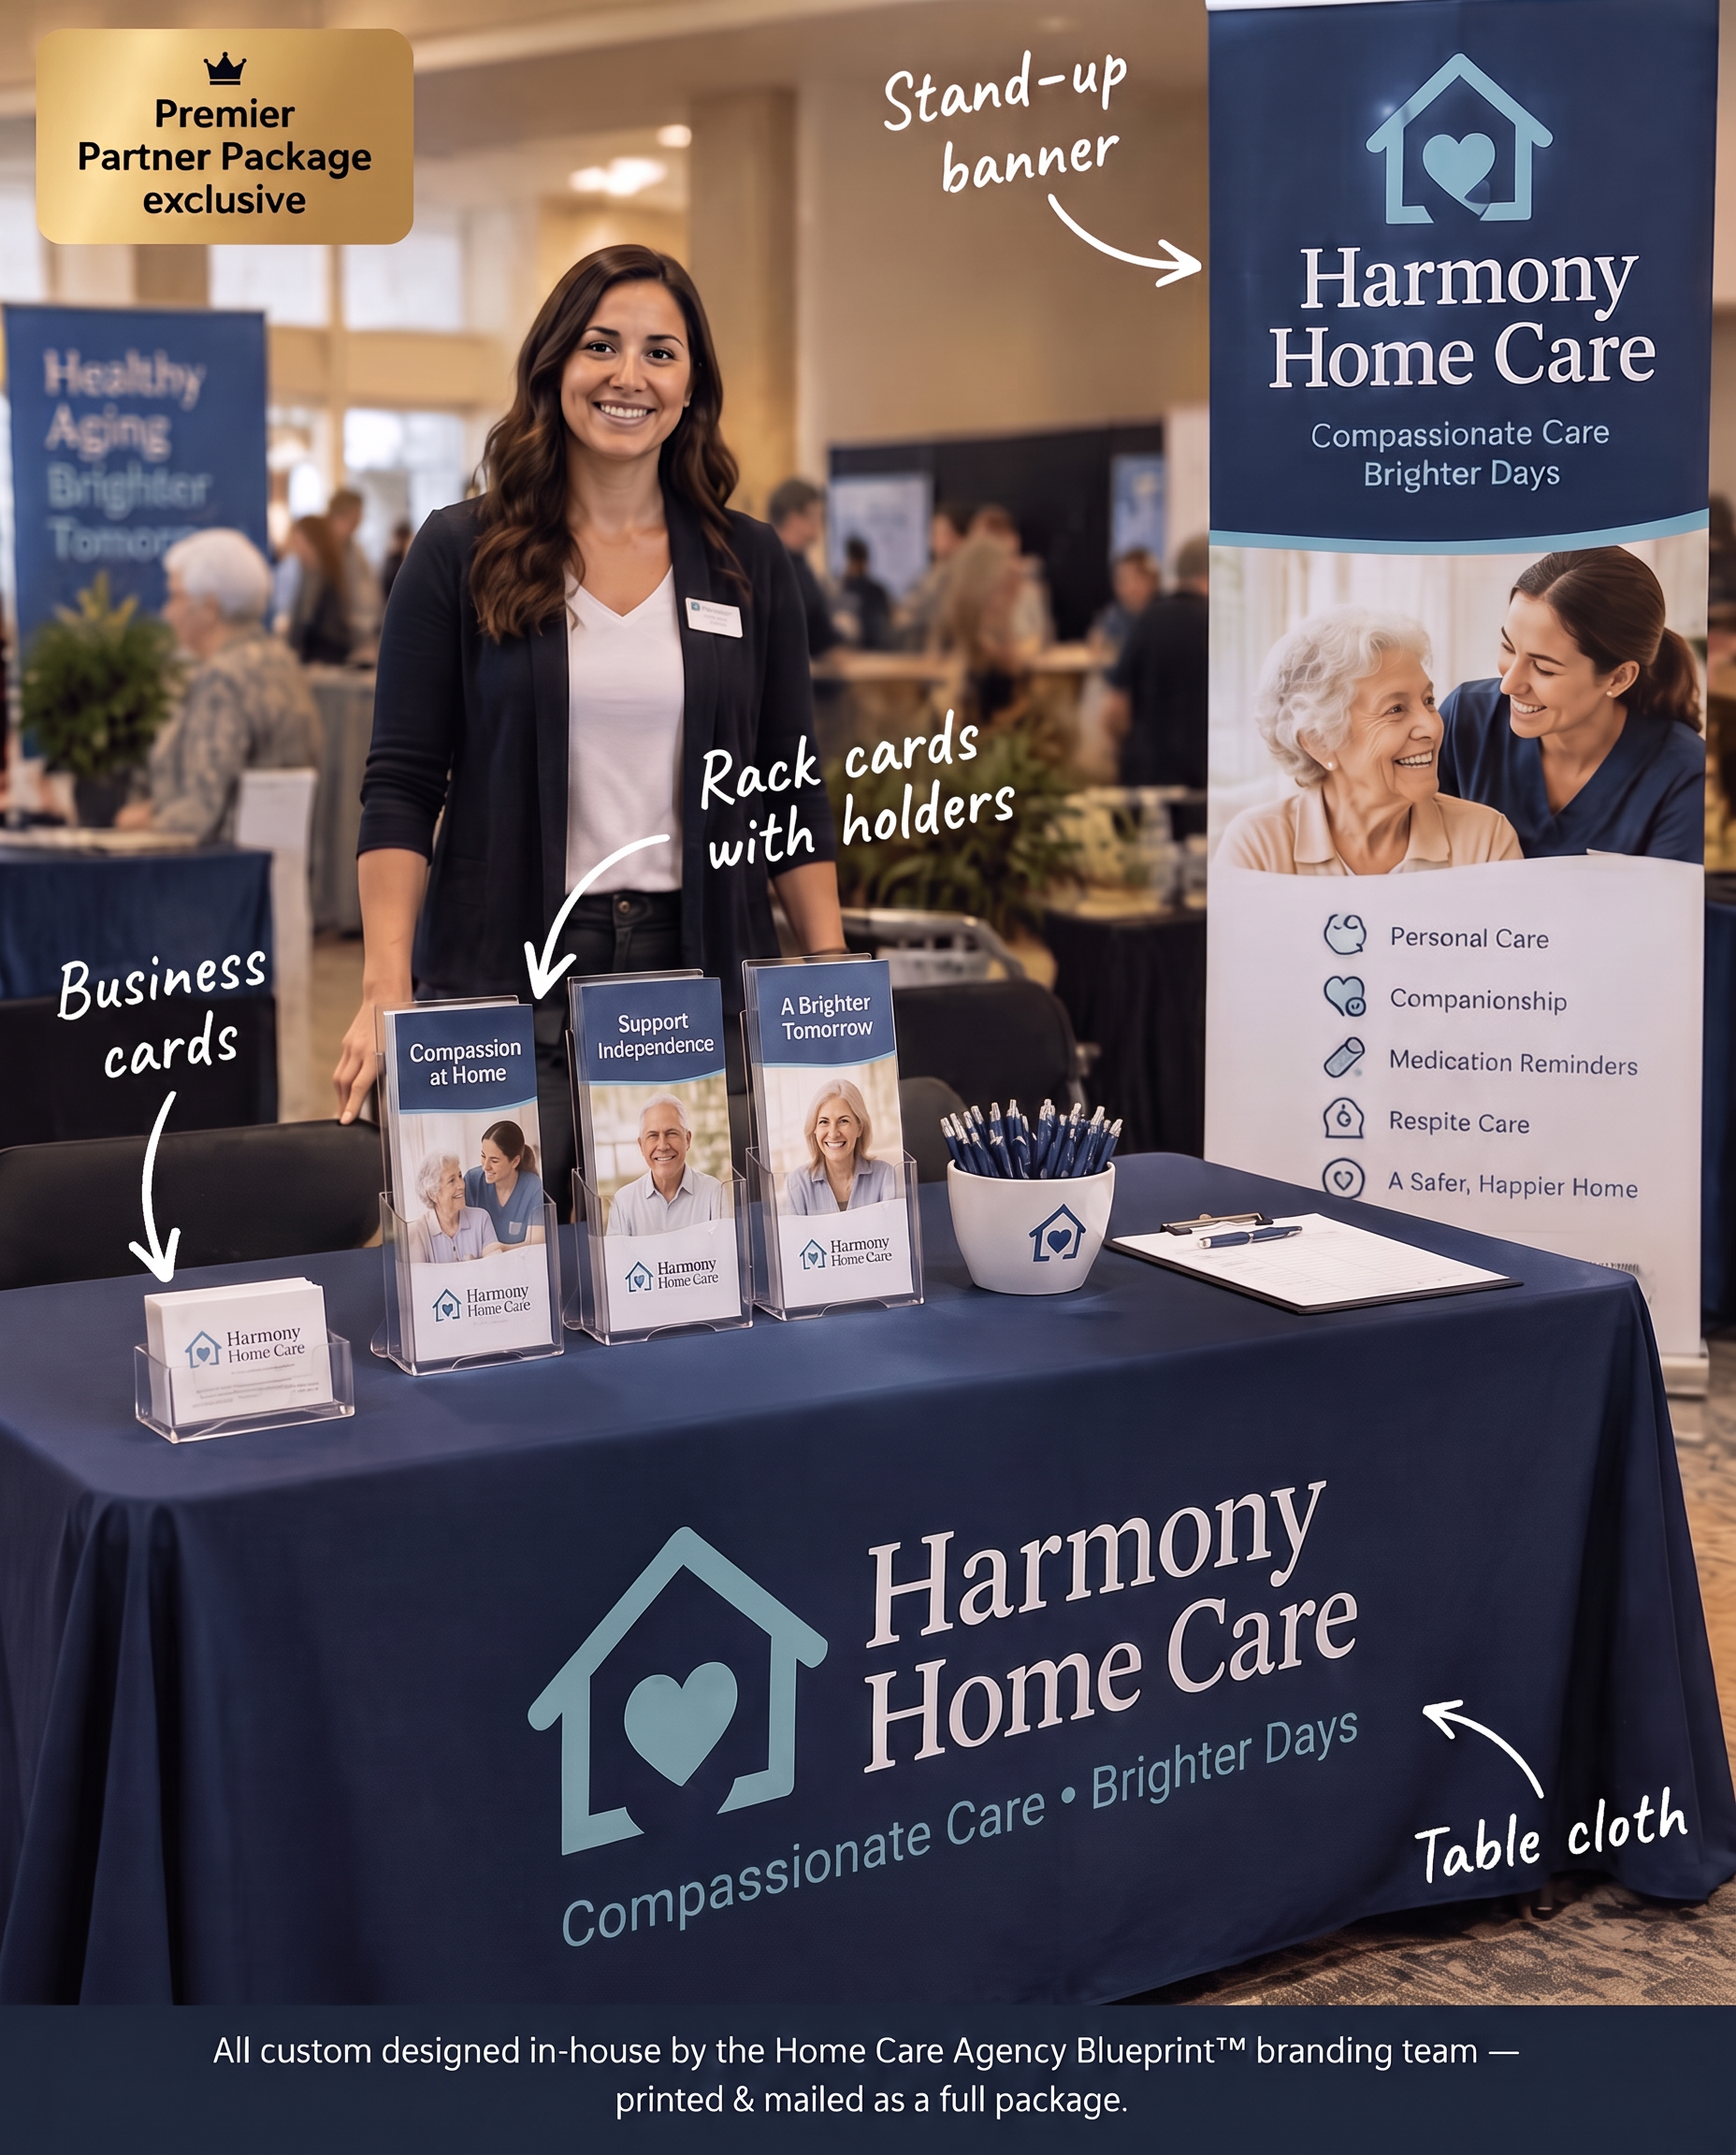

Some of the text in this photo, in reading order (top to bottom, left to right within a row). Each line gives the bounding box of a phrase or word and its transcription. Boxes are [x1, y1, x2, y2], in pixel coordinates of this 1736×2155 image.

[1300, 247, 1639, 322] Harmony
[1269, 322, 1656, 388] Home Care
[44, 348, 207, 412] Healthy
[44, 403, 172, 463] Aging
[1311, 420, 1610, 452] Compassionate Care
[1365, 459, 1560, 493] Brighter Days
[48, 459, 213, 520] Brighter
[1390, 927, 1550, 949] Personal Care
[780, 994, 871, 1018] A Brighter
[1390, 988, 1568, 1015] Companionship
[617, 1012, 688, 1036] Support
[782, 1019, 873, 1041] Tomorrow
[410, 1039, 522, 1065] Compassion
[598, 1036, 715, 1062] Independence
[429, 1064, 506, 1086] at Home
[1389, 1049, 1639, 1077] Medication Reminders
[1389, 1110, 1530, 1135] Respite Care
[1388, 1173, 1639, 1199] A Safer, Happier Home
[831, 1238, 890, 1252] Harmony
[658, 1260, 716, 1275] Harmony
[832, 1251, 892, 1266] Home Care
[658, 1274, 718, 1289] Home Care
[467, 1287, 528, 1303] Harmony
[504, 1301, 531, 1312] Care
[227, 1328, 300, 1347] Harmony
[228, 1343, 305, 1363] Home Care
[866, 1480, 1326, 1649] Harmony
[863, 1591, 1358, 1774] Home Care
[561, 1818, 933, 1948] Compassionate
[946, 1790, 1046, 1846] Care
[1092, 1733, 1251, 1811] Brighter
[1266, 1711, 1360, 1765] Days
